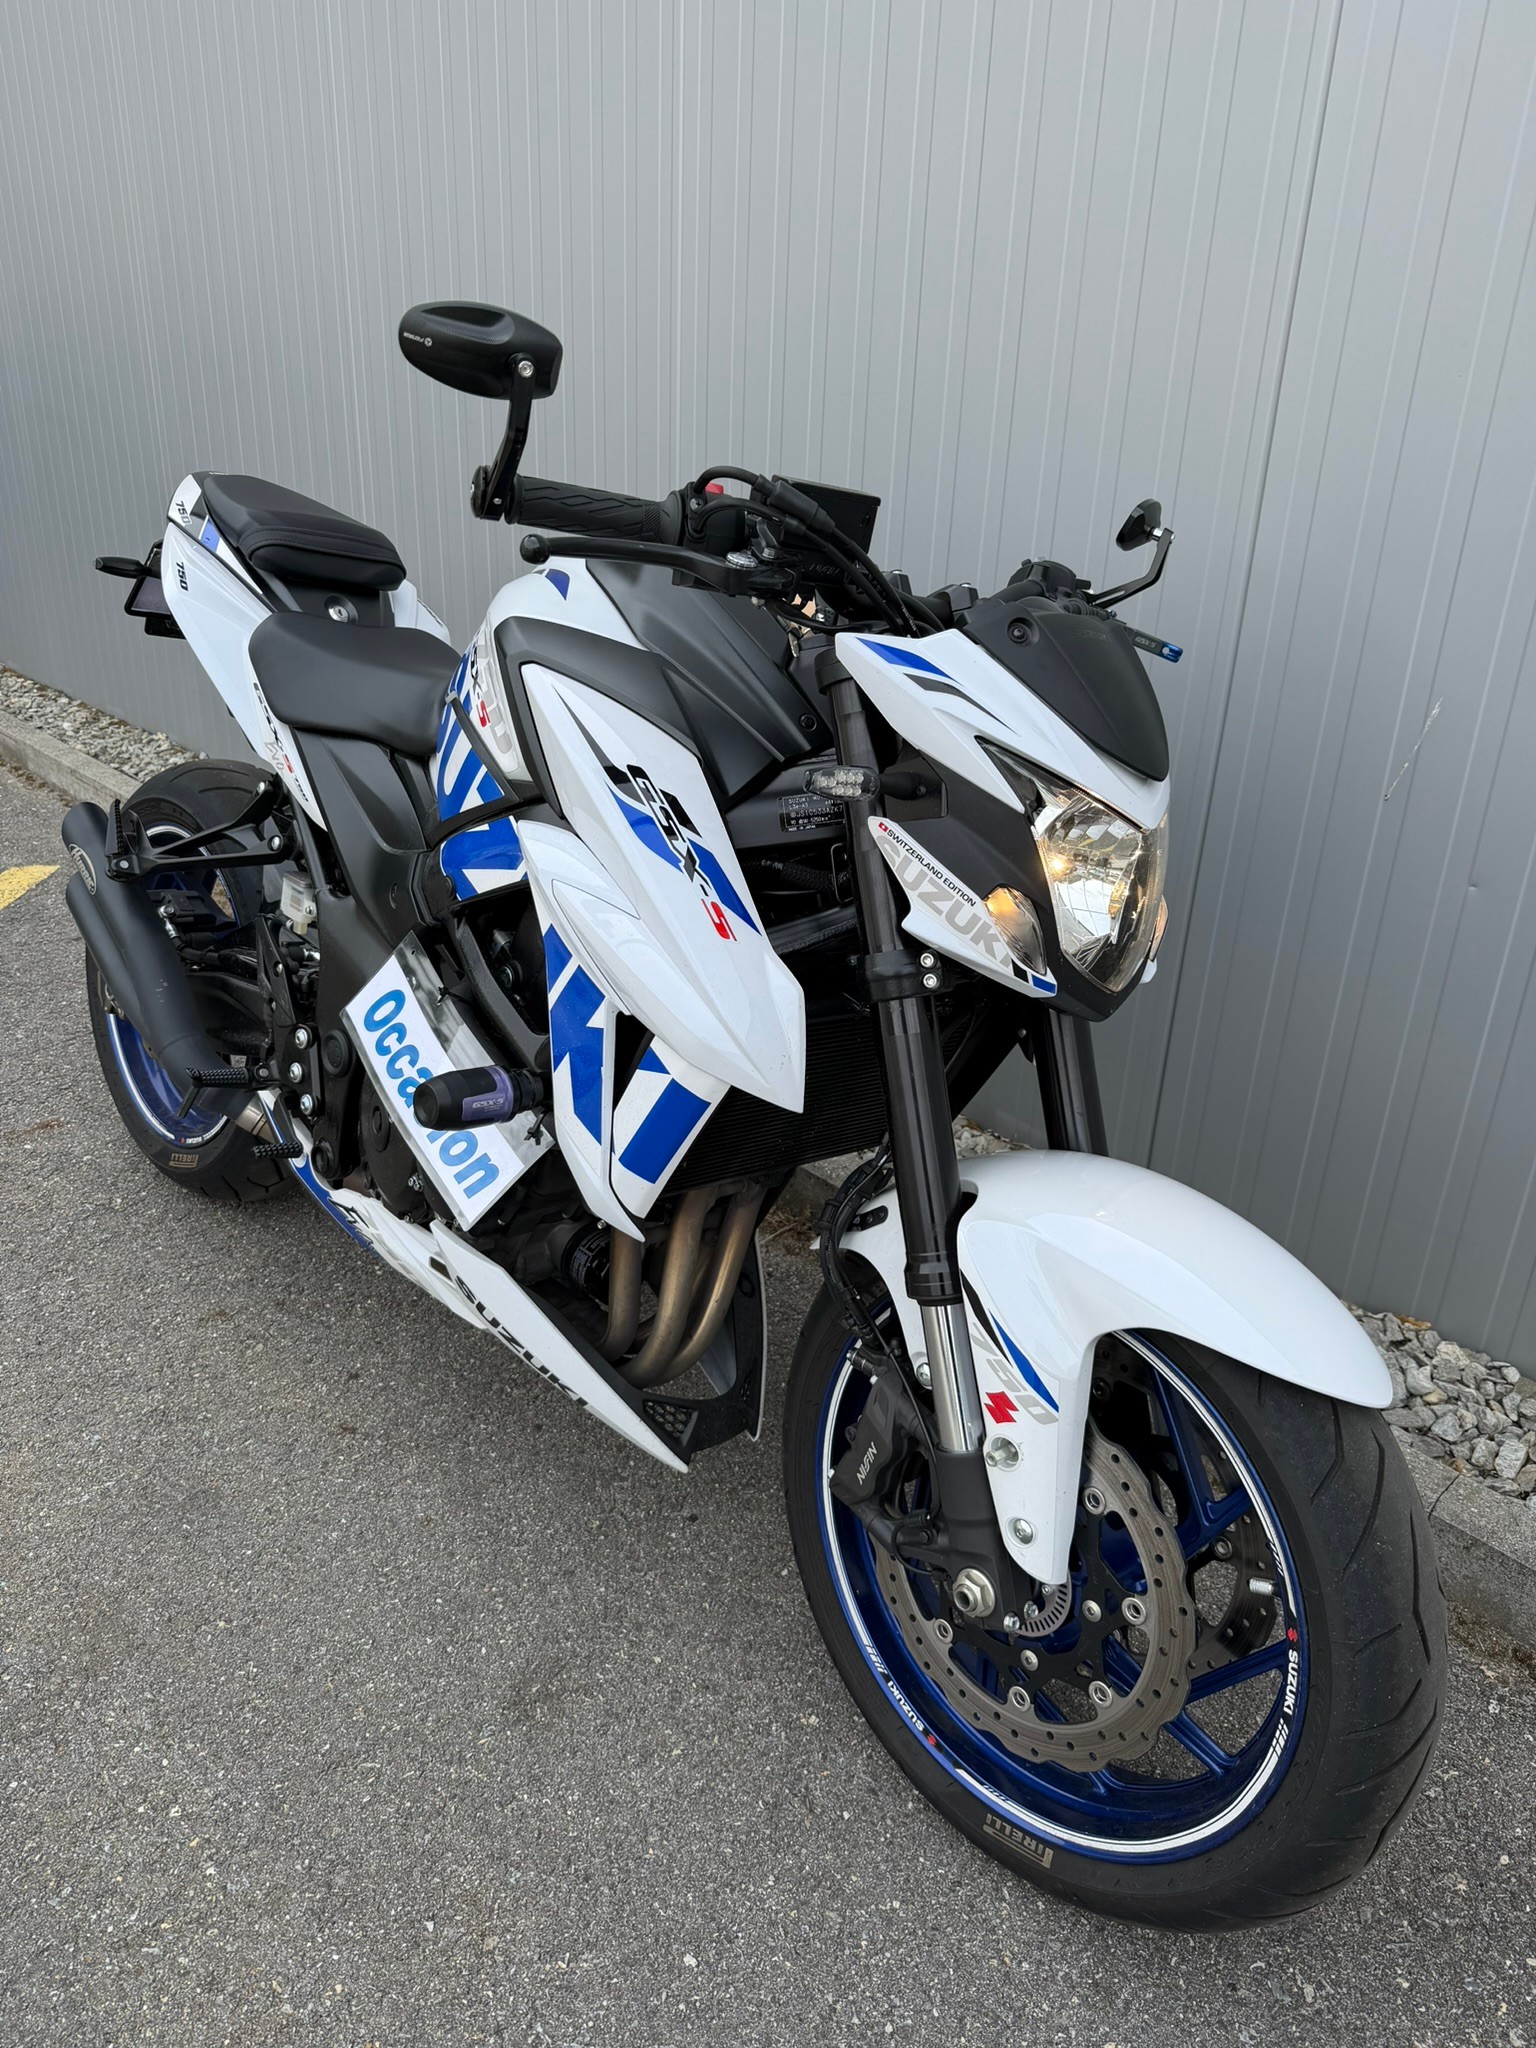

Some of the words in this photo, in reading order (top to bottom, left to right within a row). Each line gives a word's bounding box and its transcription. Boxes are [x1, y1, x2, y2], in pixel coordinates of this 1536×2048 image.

[176, 561, 189, 591] 750
[626, 764, 738, 942] GSX-S
[887, 829, 943, 880] SWITZERLAND
[943, 877, 977, 907] EDITION
[875, 834, 1012, 968] SUZUKI
[363, 989, 500, 1199] Occaon
[455, 1275, 589, 1407] SUZUKI
[971, 1321, 1059, 1425] 750
[887, 1680, 926, 1732] SUZUKI
[1283, 1649, 1299, 1716] SUZUKI
[983, 1812, 1054, 1869] PIRELLI
